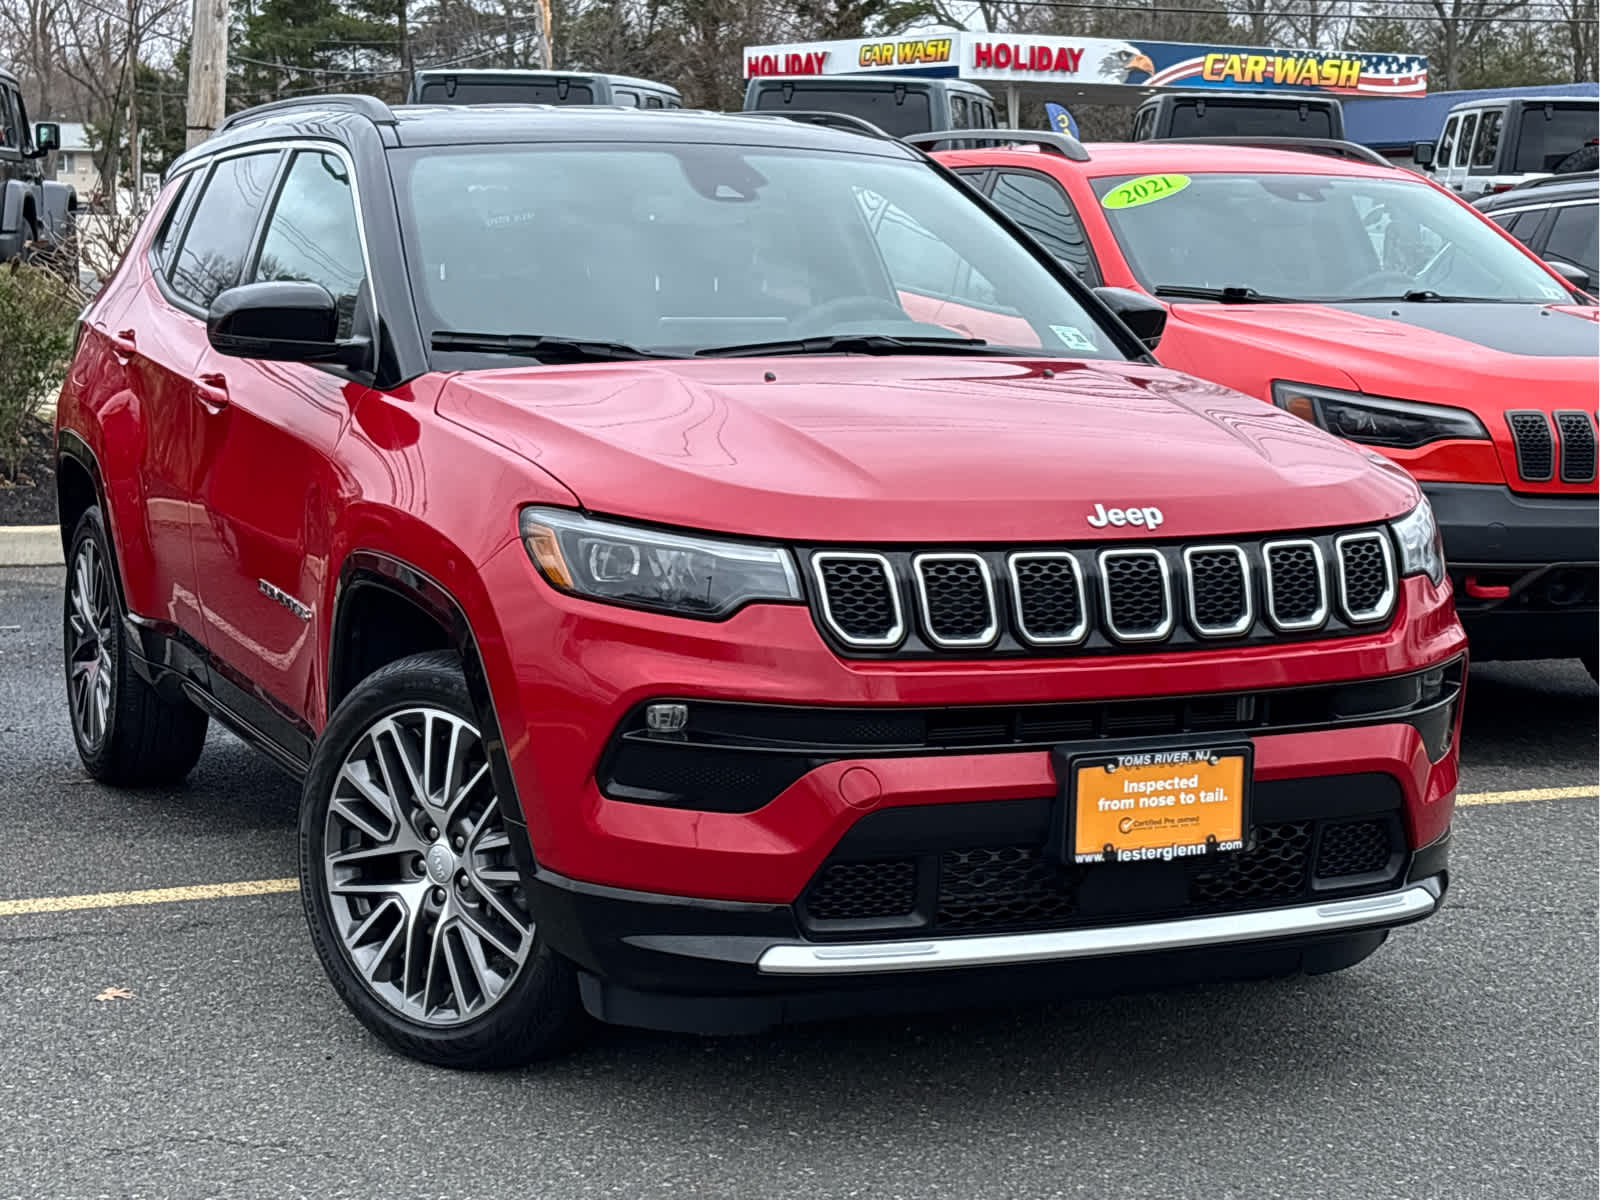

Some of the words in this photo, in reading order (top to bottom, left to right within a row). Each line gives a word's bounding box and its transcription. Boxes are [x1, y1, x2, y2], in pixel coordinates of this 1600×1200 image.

[747, 52, 828, 79] HOLIDAY
[859, 43, 893, 67] CAR
[897, 39, 952, 64] WASH
[975, 42, 1084, 73] HOLIDAY
[1202, 53, 1267, 83] CAR
[1272, 56, 1361, 87] WASH
[1119, 177, 1173, 204] 2021
[1087, 503, 1164, 530] Jeep
[1117, 755, 1151, 766] TOMS
[1195, 750, 1210, 761] NJ
[1123, 774, 1199, 794] Inspected
[1097, 798, 1135, 812] from
[1139, 795, 1176, 808] nose
[1180, 791, 1195, 805] to
[1199, 787, 1229, 803] tail.
[1075, 853, 1105, 864] www.
[1117, 844, 1206, 862] lesterglenn
[1216, 839, 1243, 851] .com
